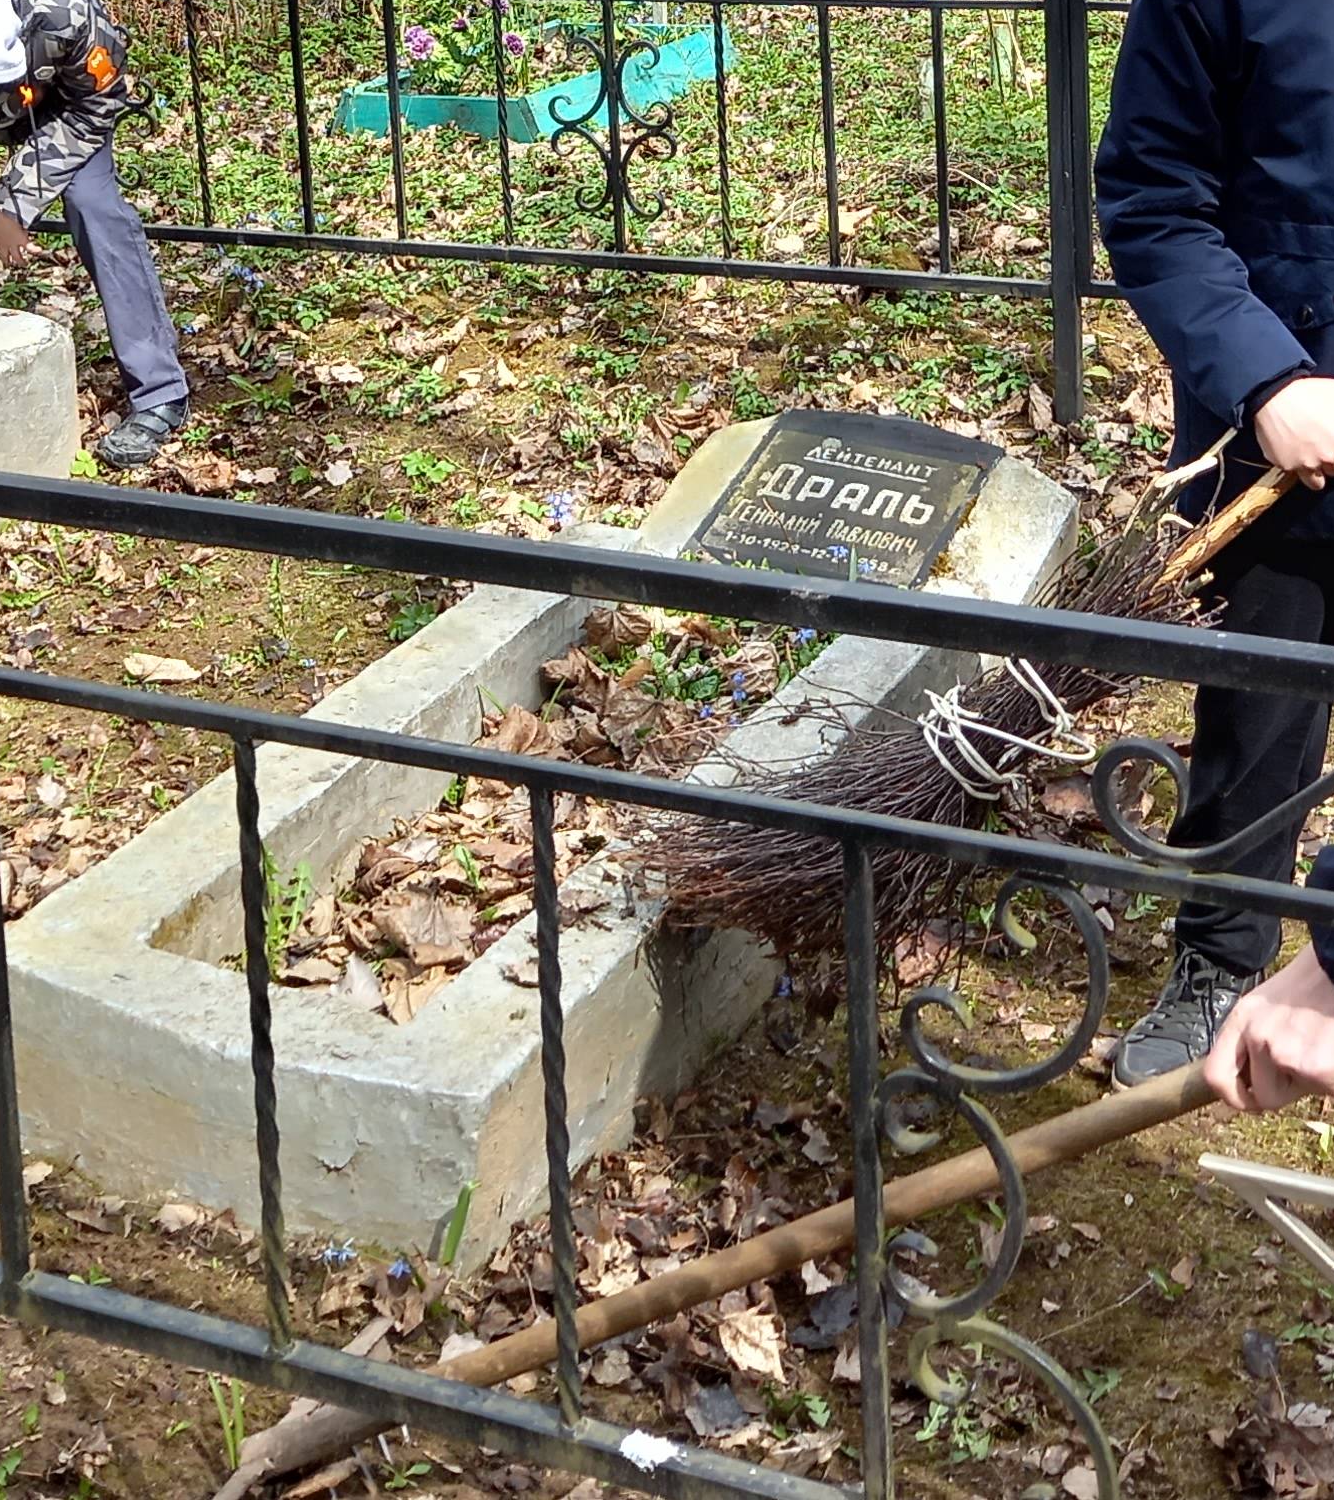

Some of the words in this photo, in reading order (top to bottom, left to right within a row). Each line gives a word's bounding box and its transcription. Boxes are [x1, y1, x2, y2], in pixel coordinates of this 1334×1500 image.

[806, 446, 939, 478] ЛЕЙТЕНАНТ
[757, 463, 935, 525] ДРАЛЬ
[826, 519, 918, 555] ПАВЛОВИЧ
